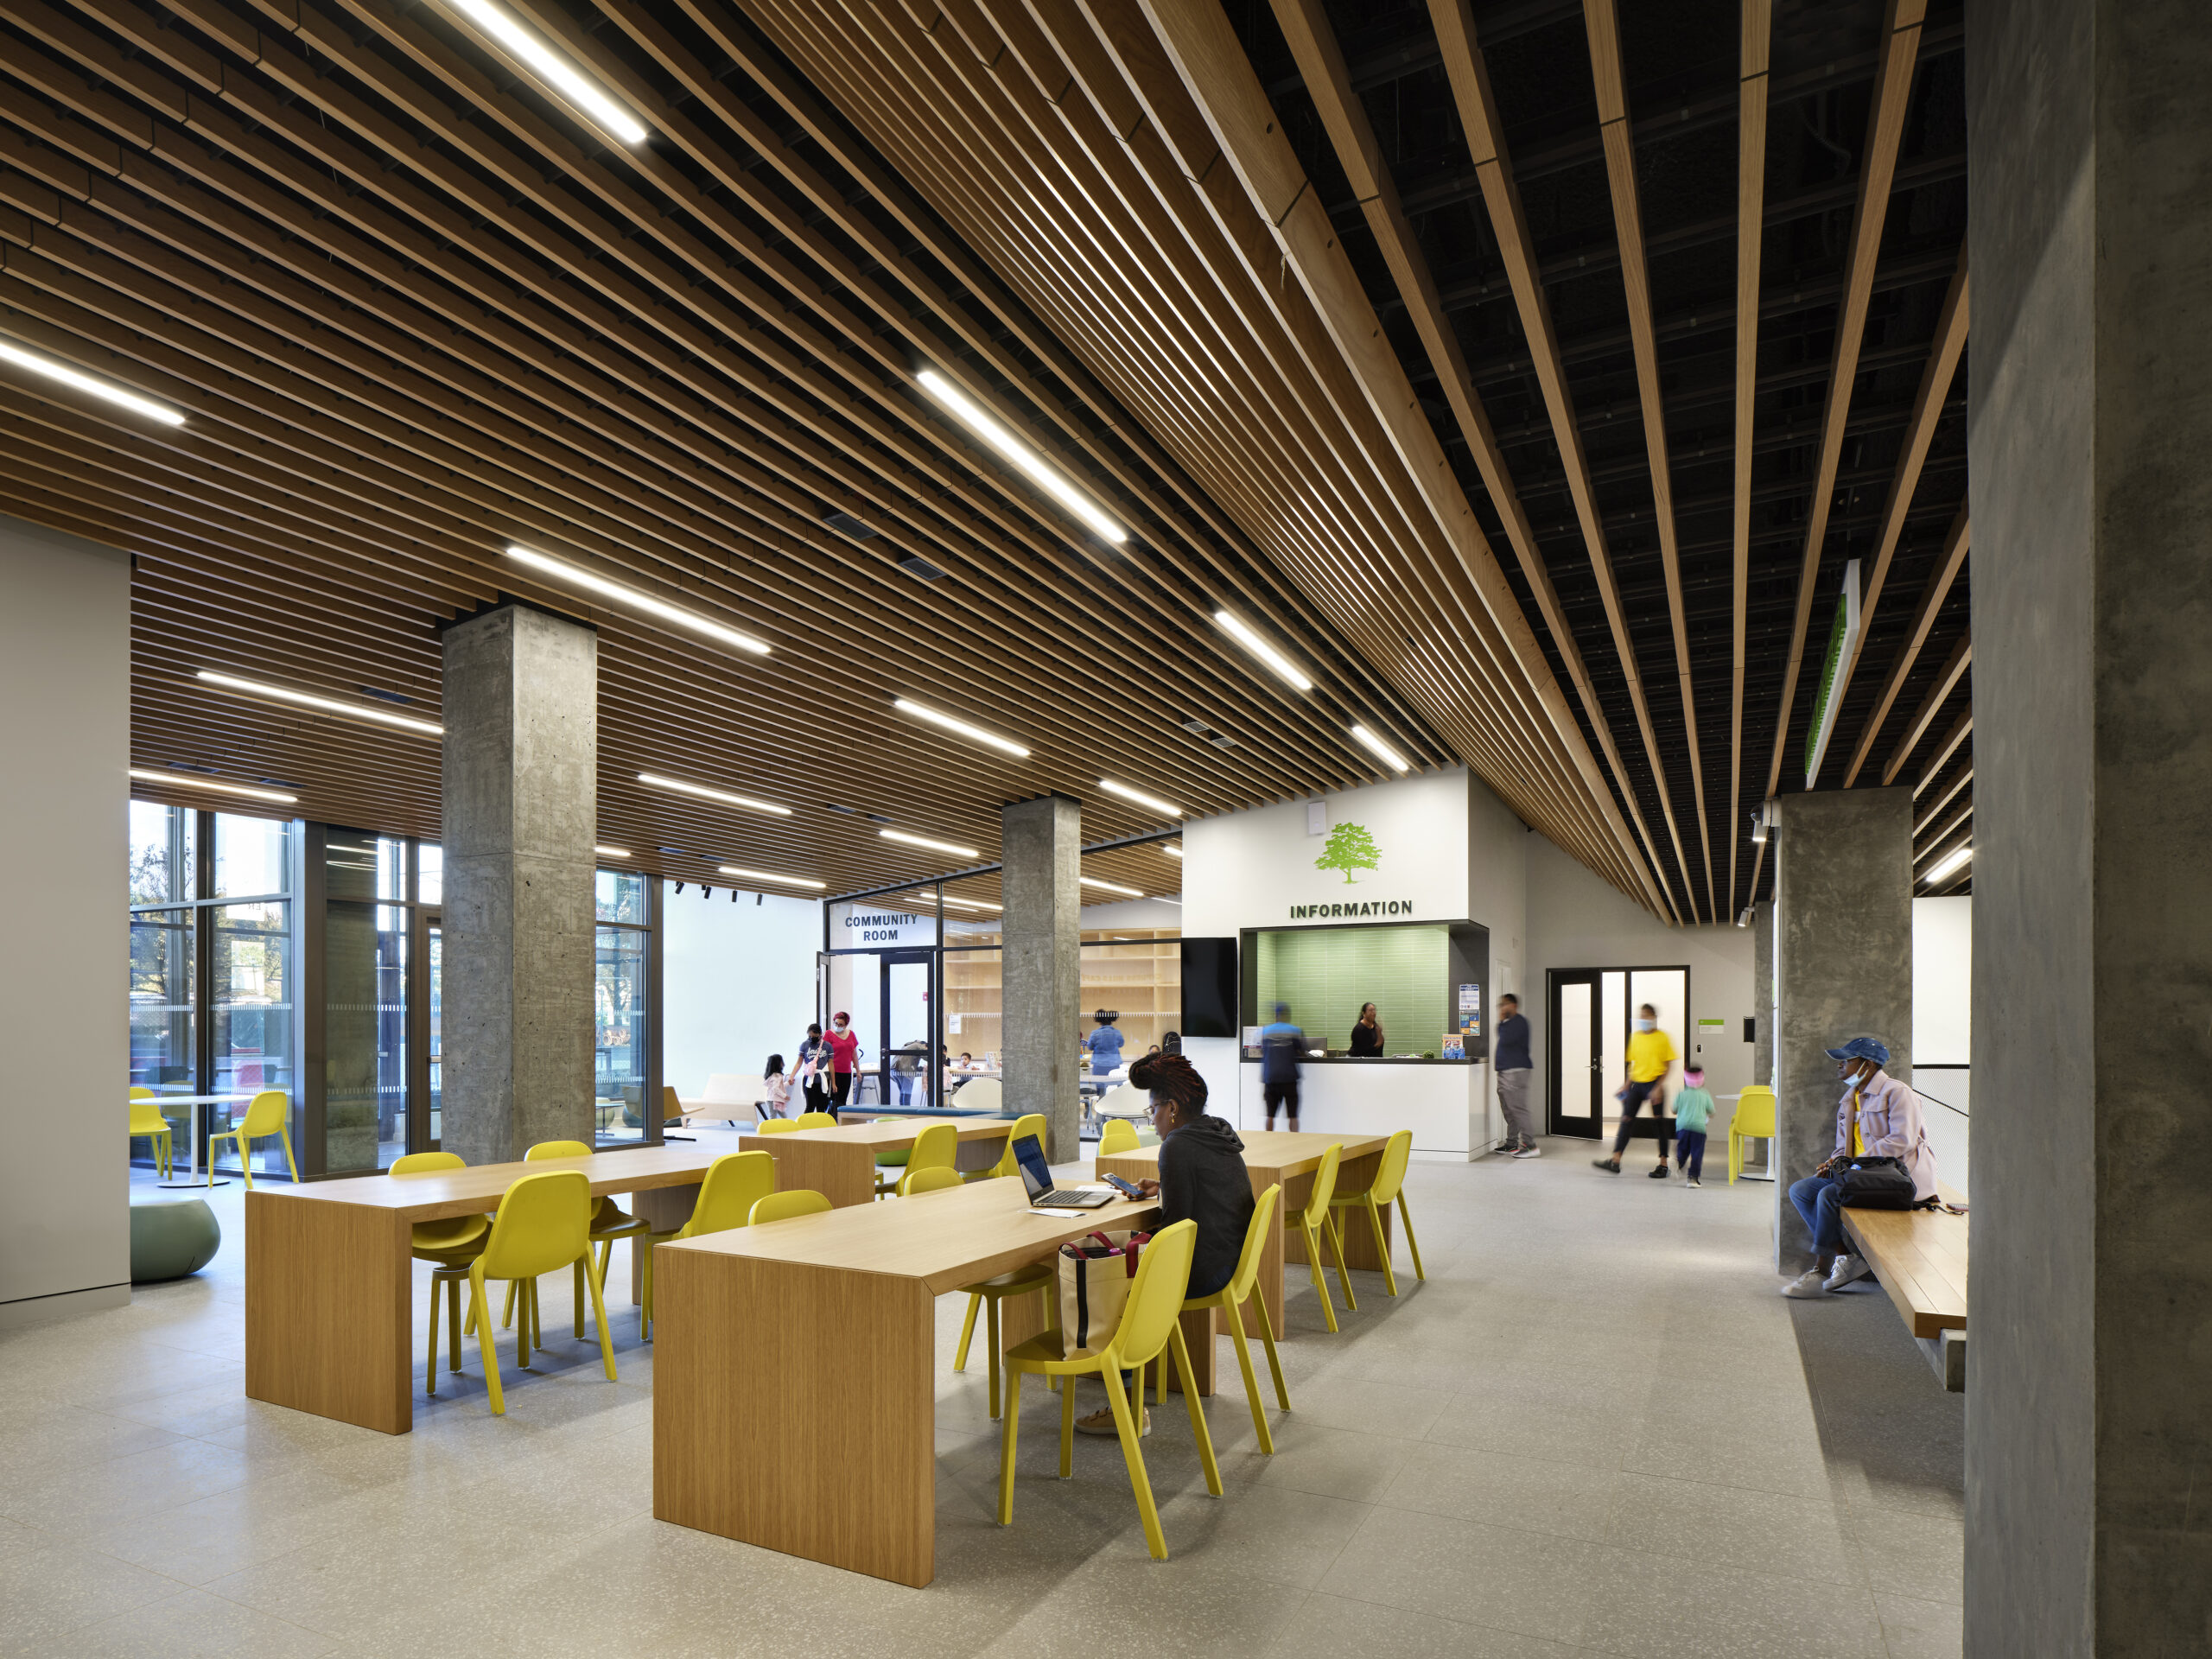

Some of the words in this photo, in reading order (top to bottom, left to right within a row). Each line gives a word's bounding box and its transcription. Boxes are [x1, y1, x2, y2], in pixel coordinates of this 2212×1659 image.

[1291, 900, 1412, 918] INFORMATION
[846, 914, 917, 927] COMMUNITY
[863, 930, 898, 941] ROOM
